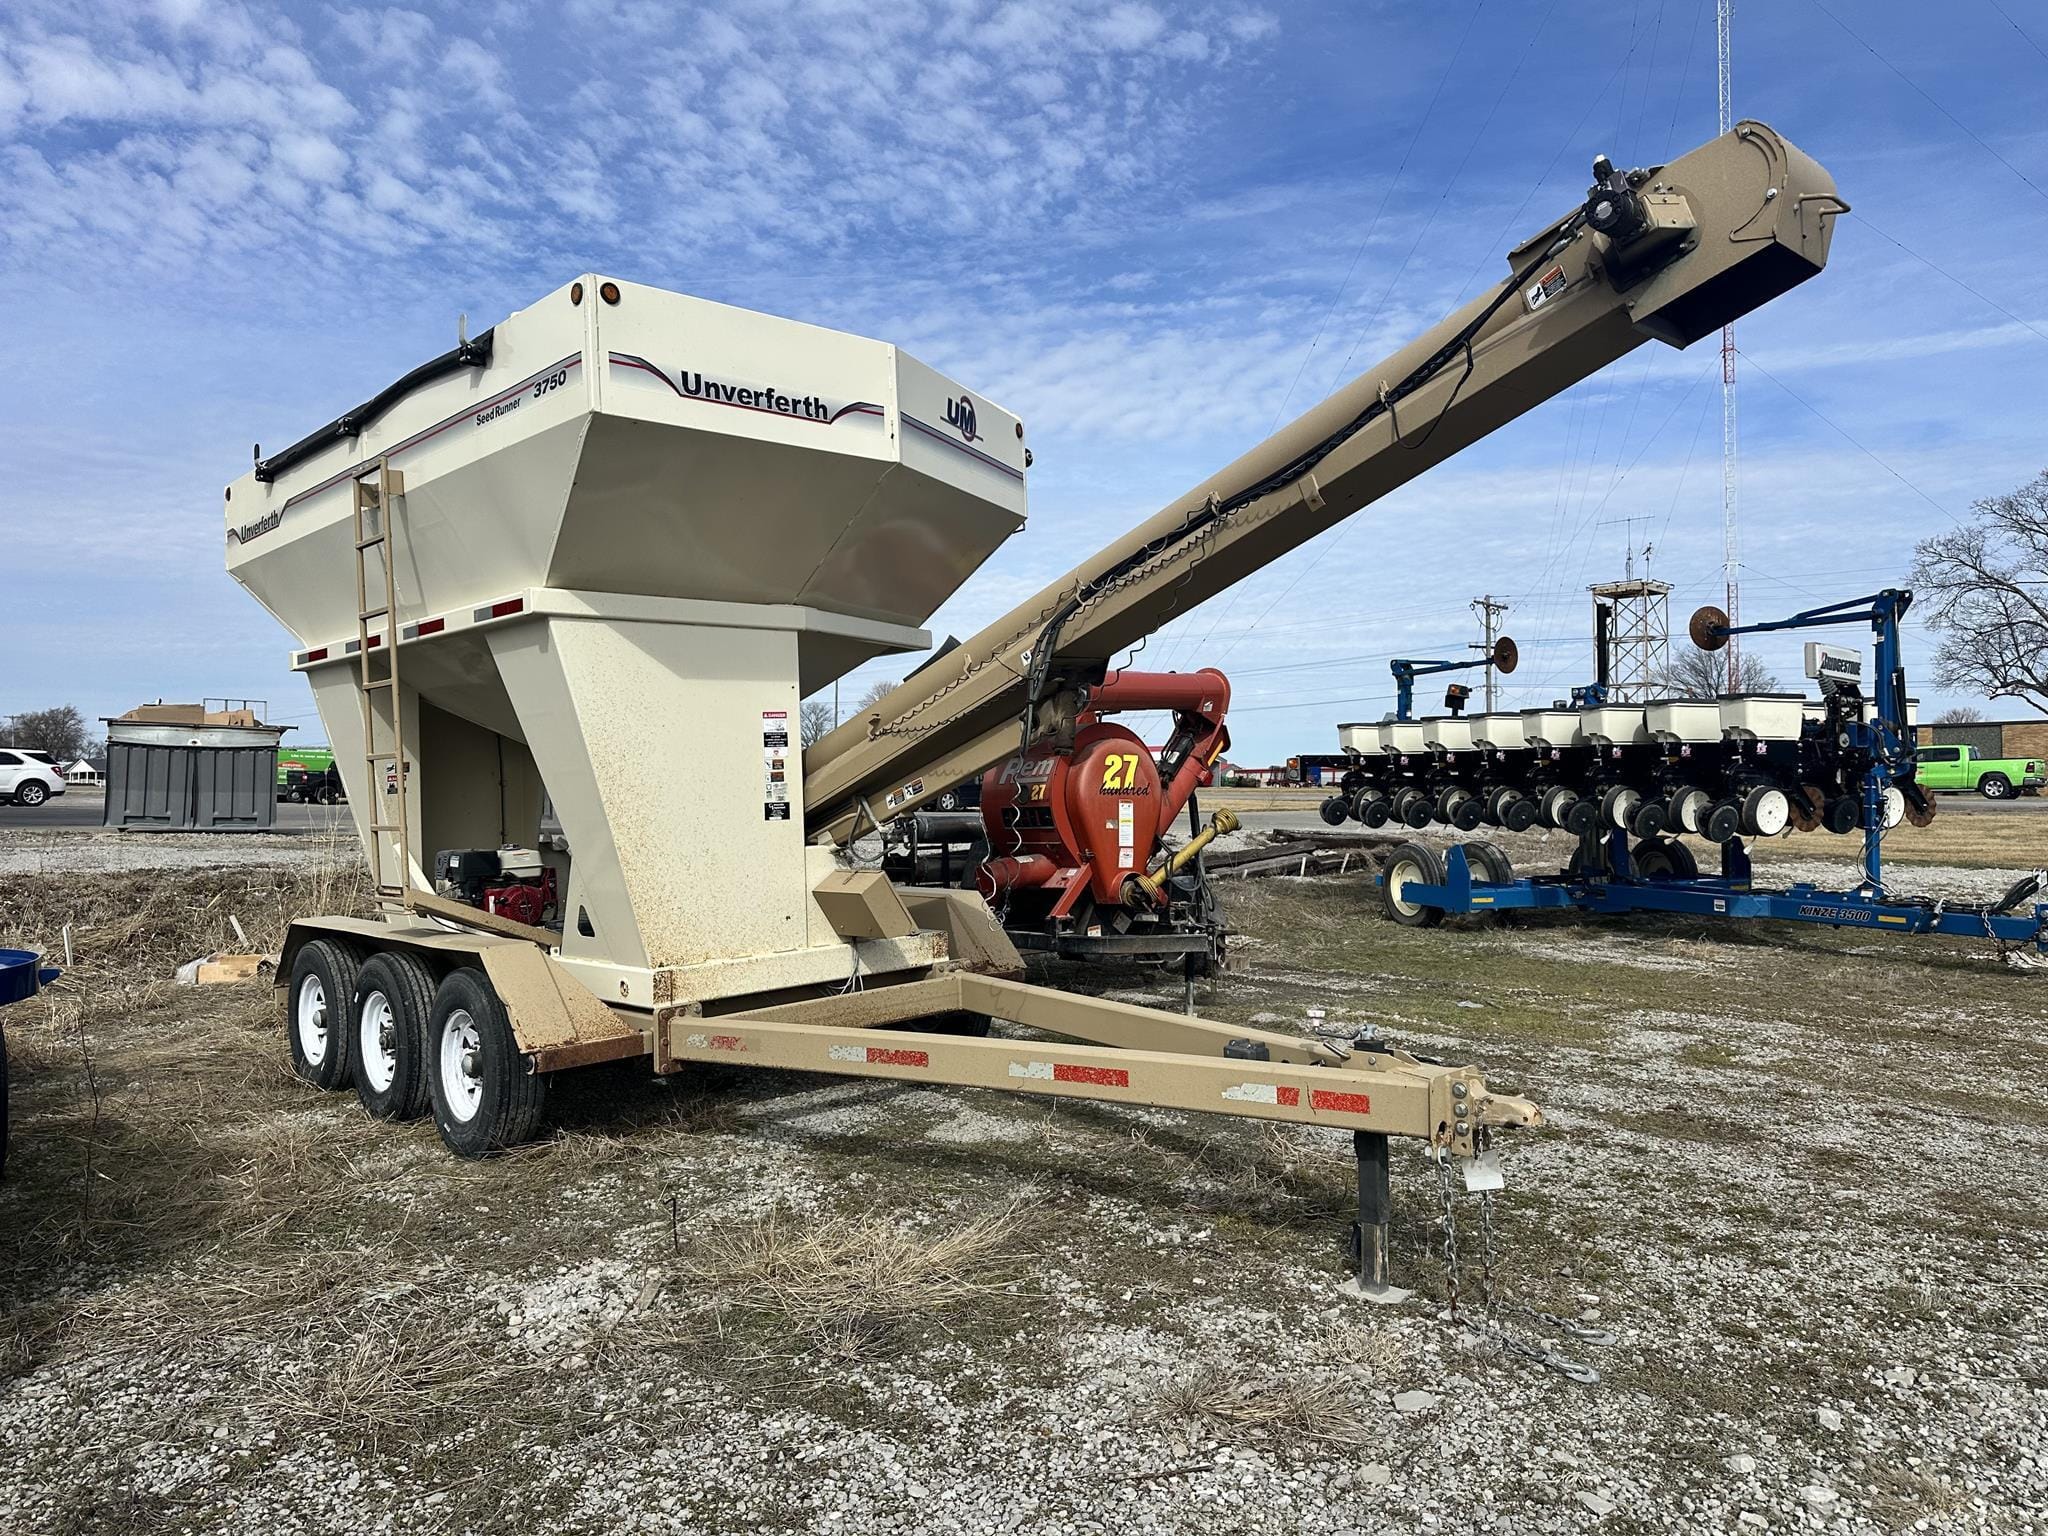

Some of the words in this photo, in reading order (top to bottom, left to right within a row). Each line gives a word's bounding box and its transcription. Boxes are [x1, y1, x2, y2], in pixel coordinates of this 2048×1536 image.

[476, 408, 495, 426] Seed
[495, 397, 521, 418] Runner
[533, 369, 567, 399] 3750
[680, 370, 829, 421] Unverferth
[240, 510, 279, 541] Unverferth
[1820, 651, 1862, 676] BRIDGESTONE
[998, 757, 1055, 785] Rem
[1102, 754, 1140, 789] 27
[1030, 784, 1047, 801] 27
[1099, 780, 1151, 797] hundred
[1798, 905, 1838, 918] KINZE
[1839, 908, 1872, 923] 3500
